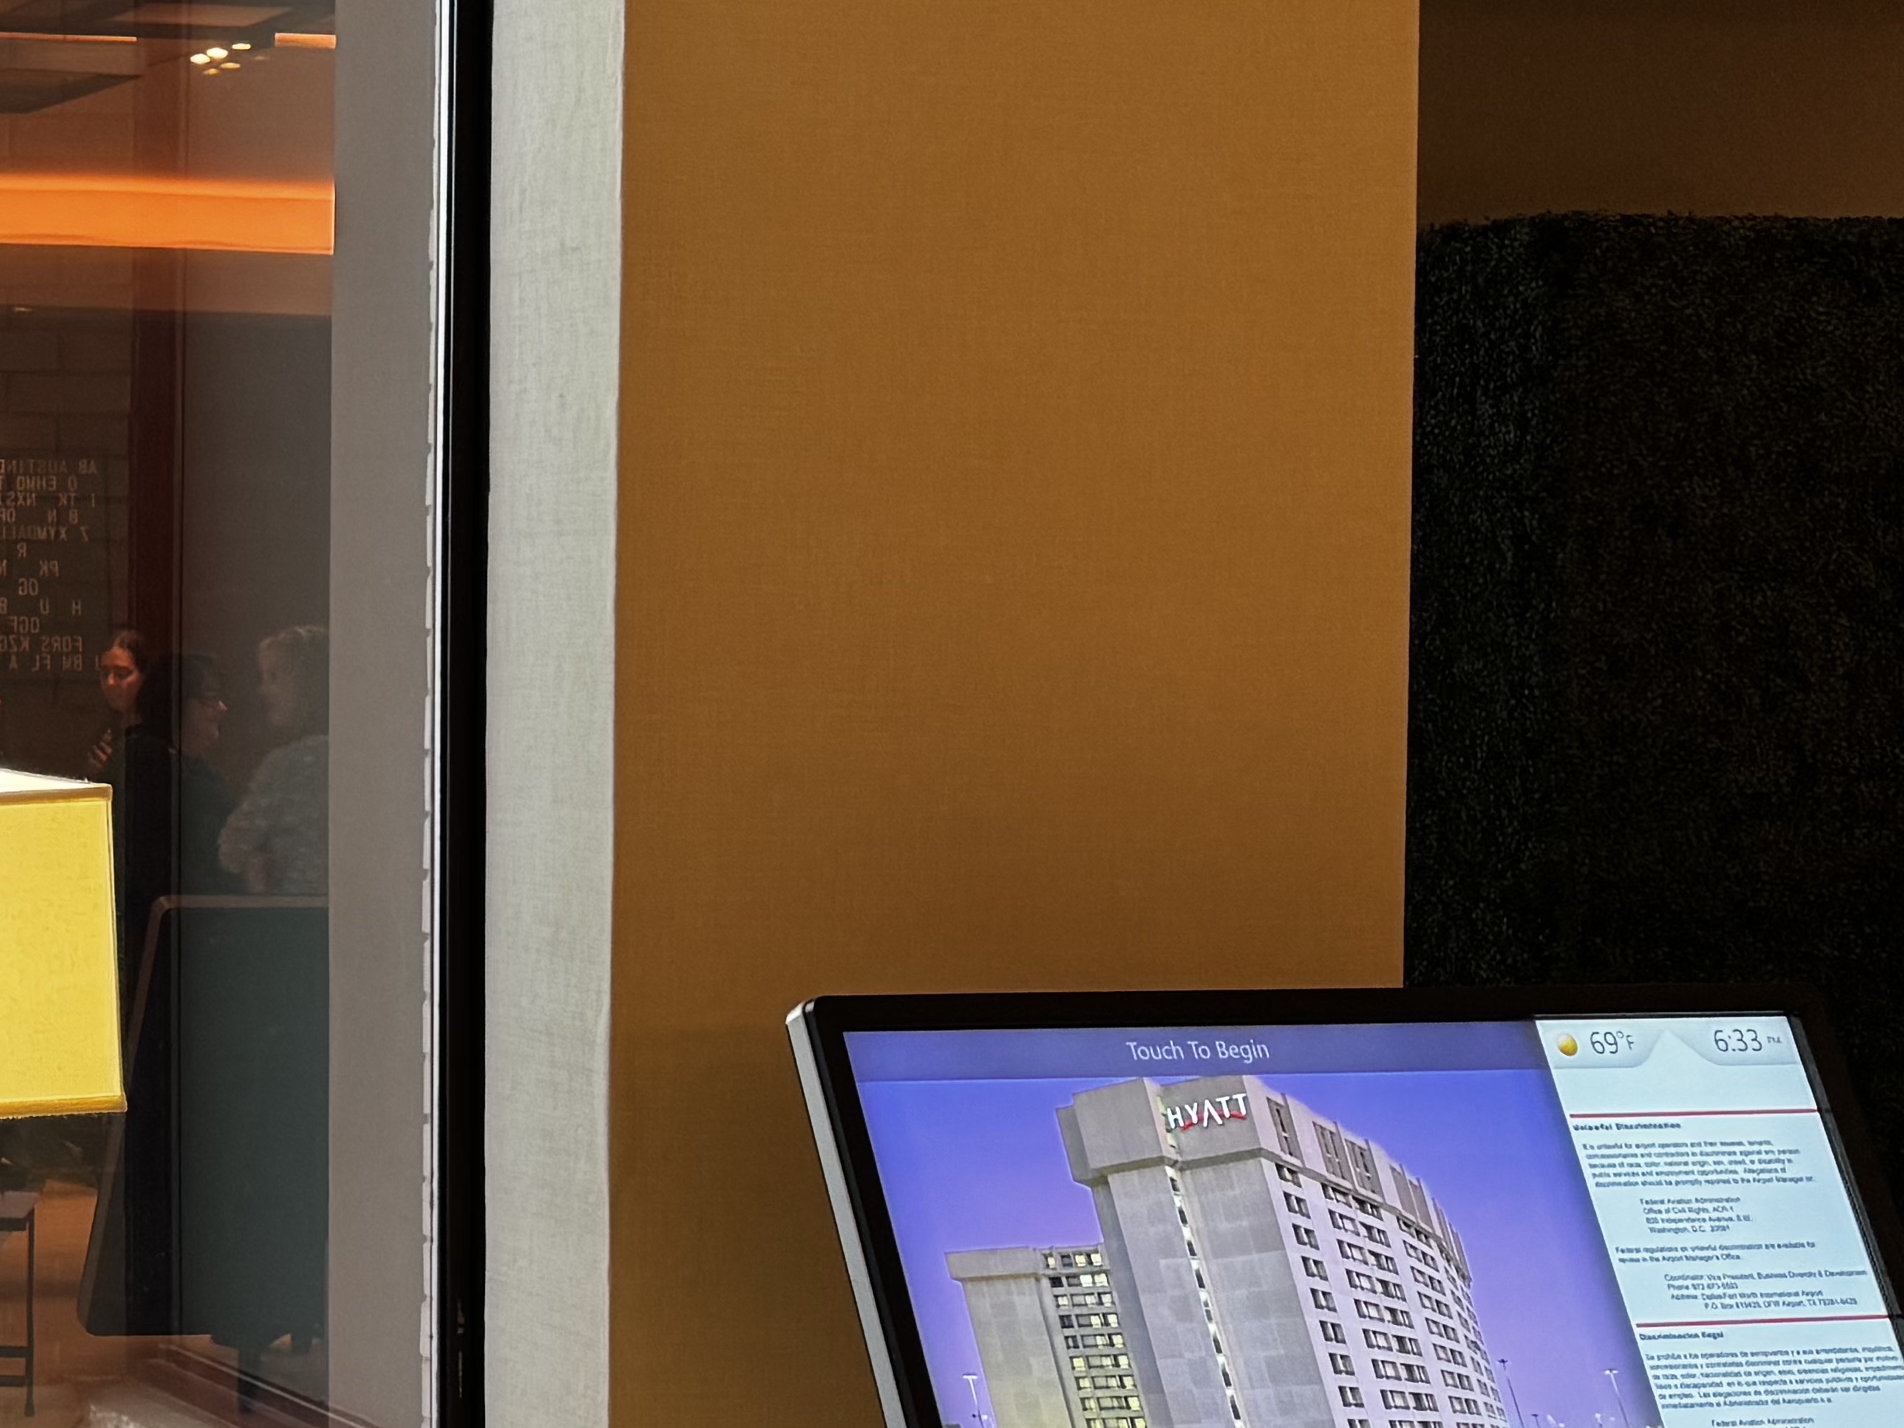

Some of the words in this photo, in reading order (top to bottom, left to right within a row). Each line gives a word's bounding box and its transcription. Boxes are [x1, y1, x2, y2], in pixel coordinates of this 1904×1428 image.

[1126, 1040, 1184, 1061] Touch
[1187, 1041, 1211, 1060] To
[1215, 1039, 1270, 1064] Begin
[1714, 1029, 1763, 1052] 6:33
[1166, 1093, 1248, 1129] HYATT
